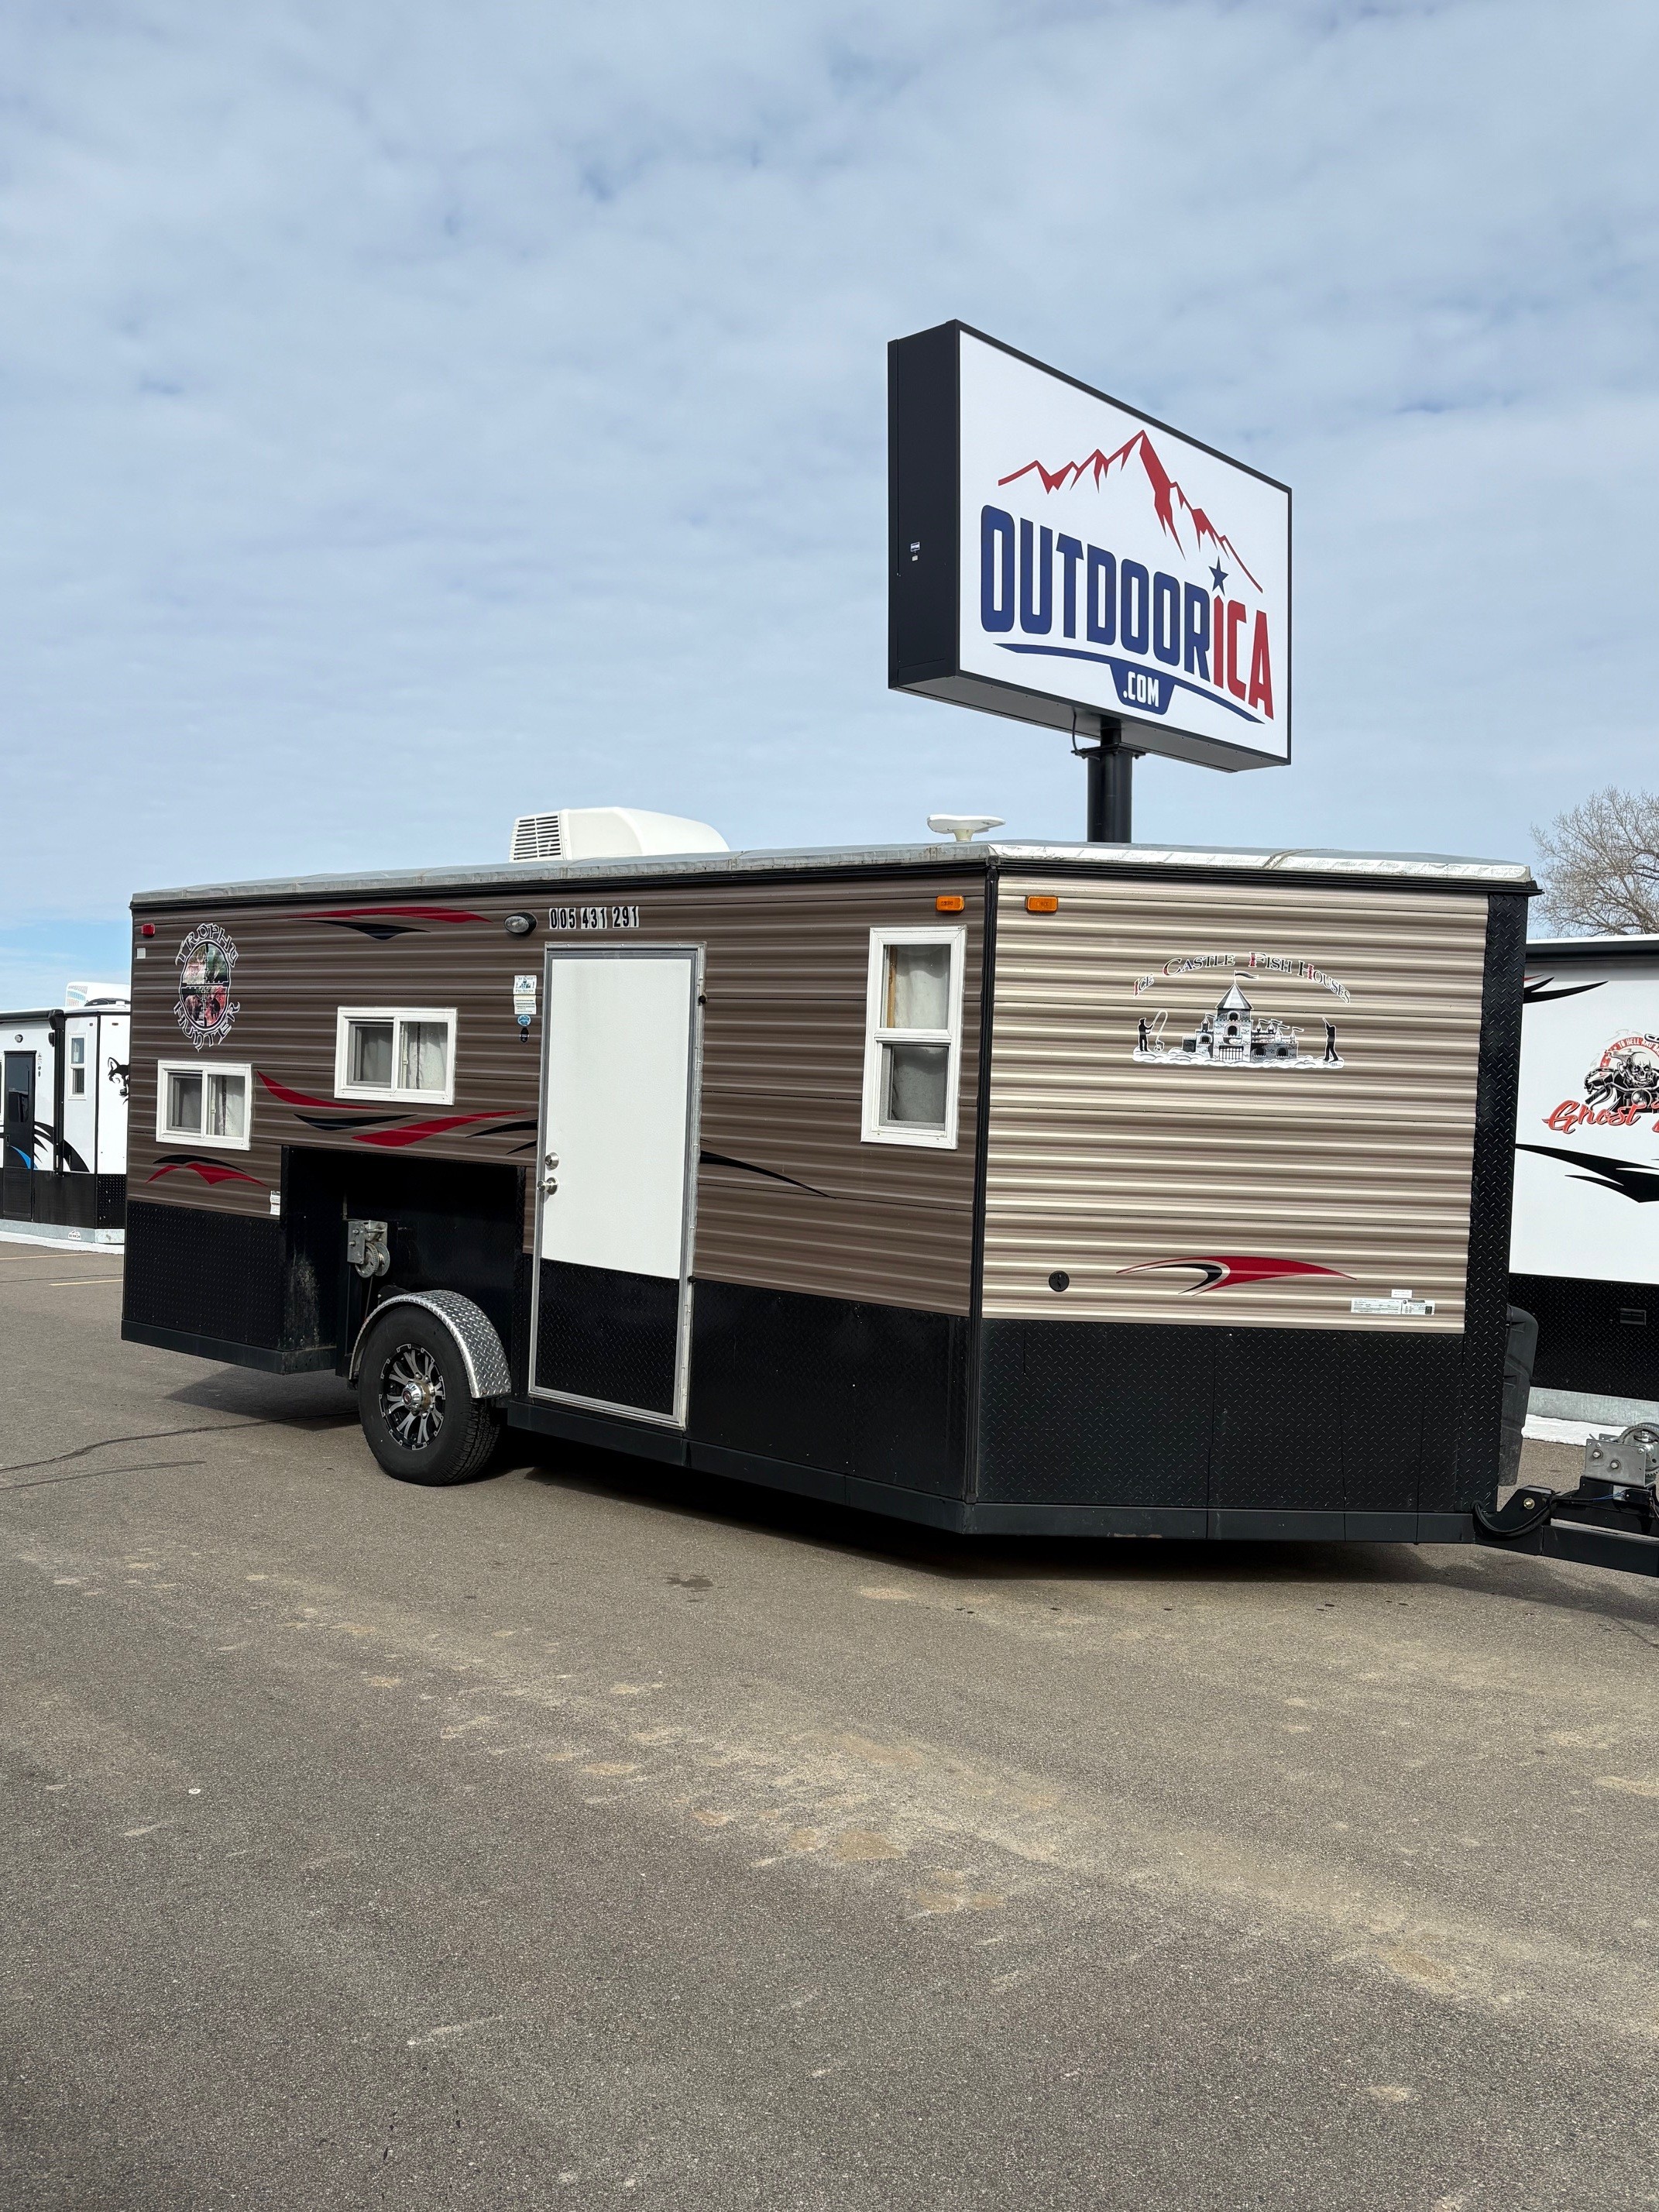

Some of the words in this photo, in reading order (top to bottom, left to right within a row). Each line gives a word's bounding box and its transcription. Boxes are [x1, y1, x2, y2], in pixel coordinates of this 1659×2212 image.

[981, 504, 1274, 720] OUTDOORICA
[1123, 671, 1159, 707] .COM
[550, 908, 576, 929] 005
[582, 908, 606, 929] 431
[613, 906, 638, 928] 291
[1133, 974, 1154, 998] ICE
[1163, 954, 1236, 977] CASTLE
[1249, 952, 1293, 973] FISH
[1297, 960, 1351, 1005] HOUSES
[1542, 1100, 1646, 1134] Ghost
